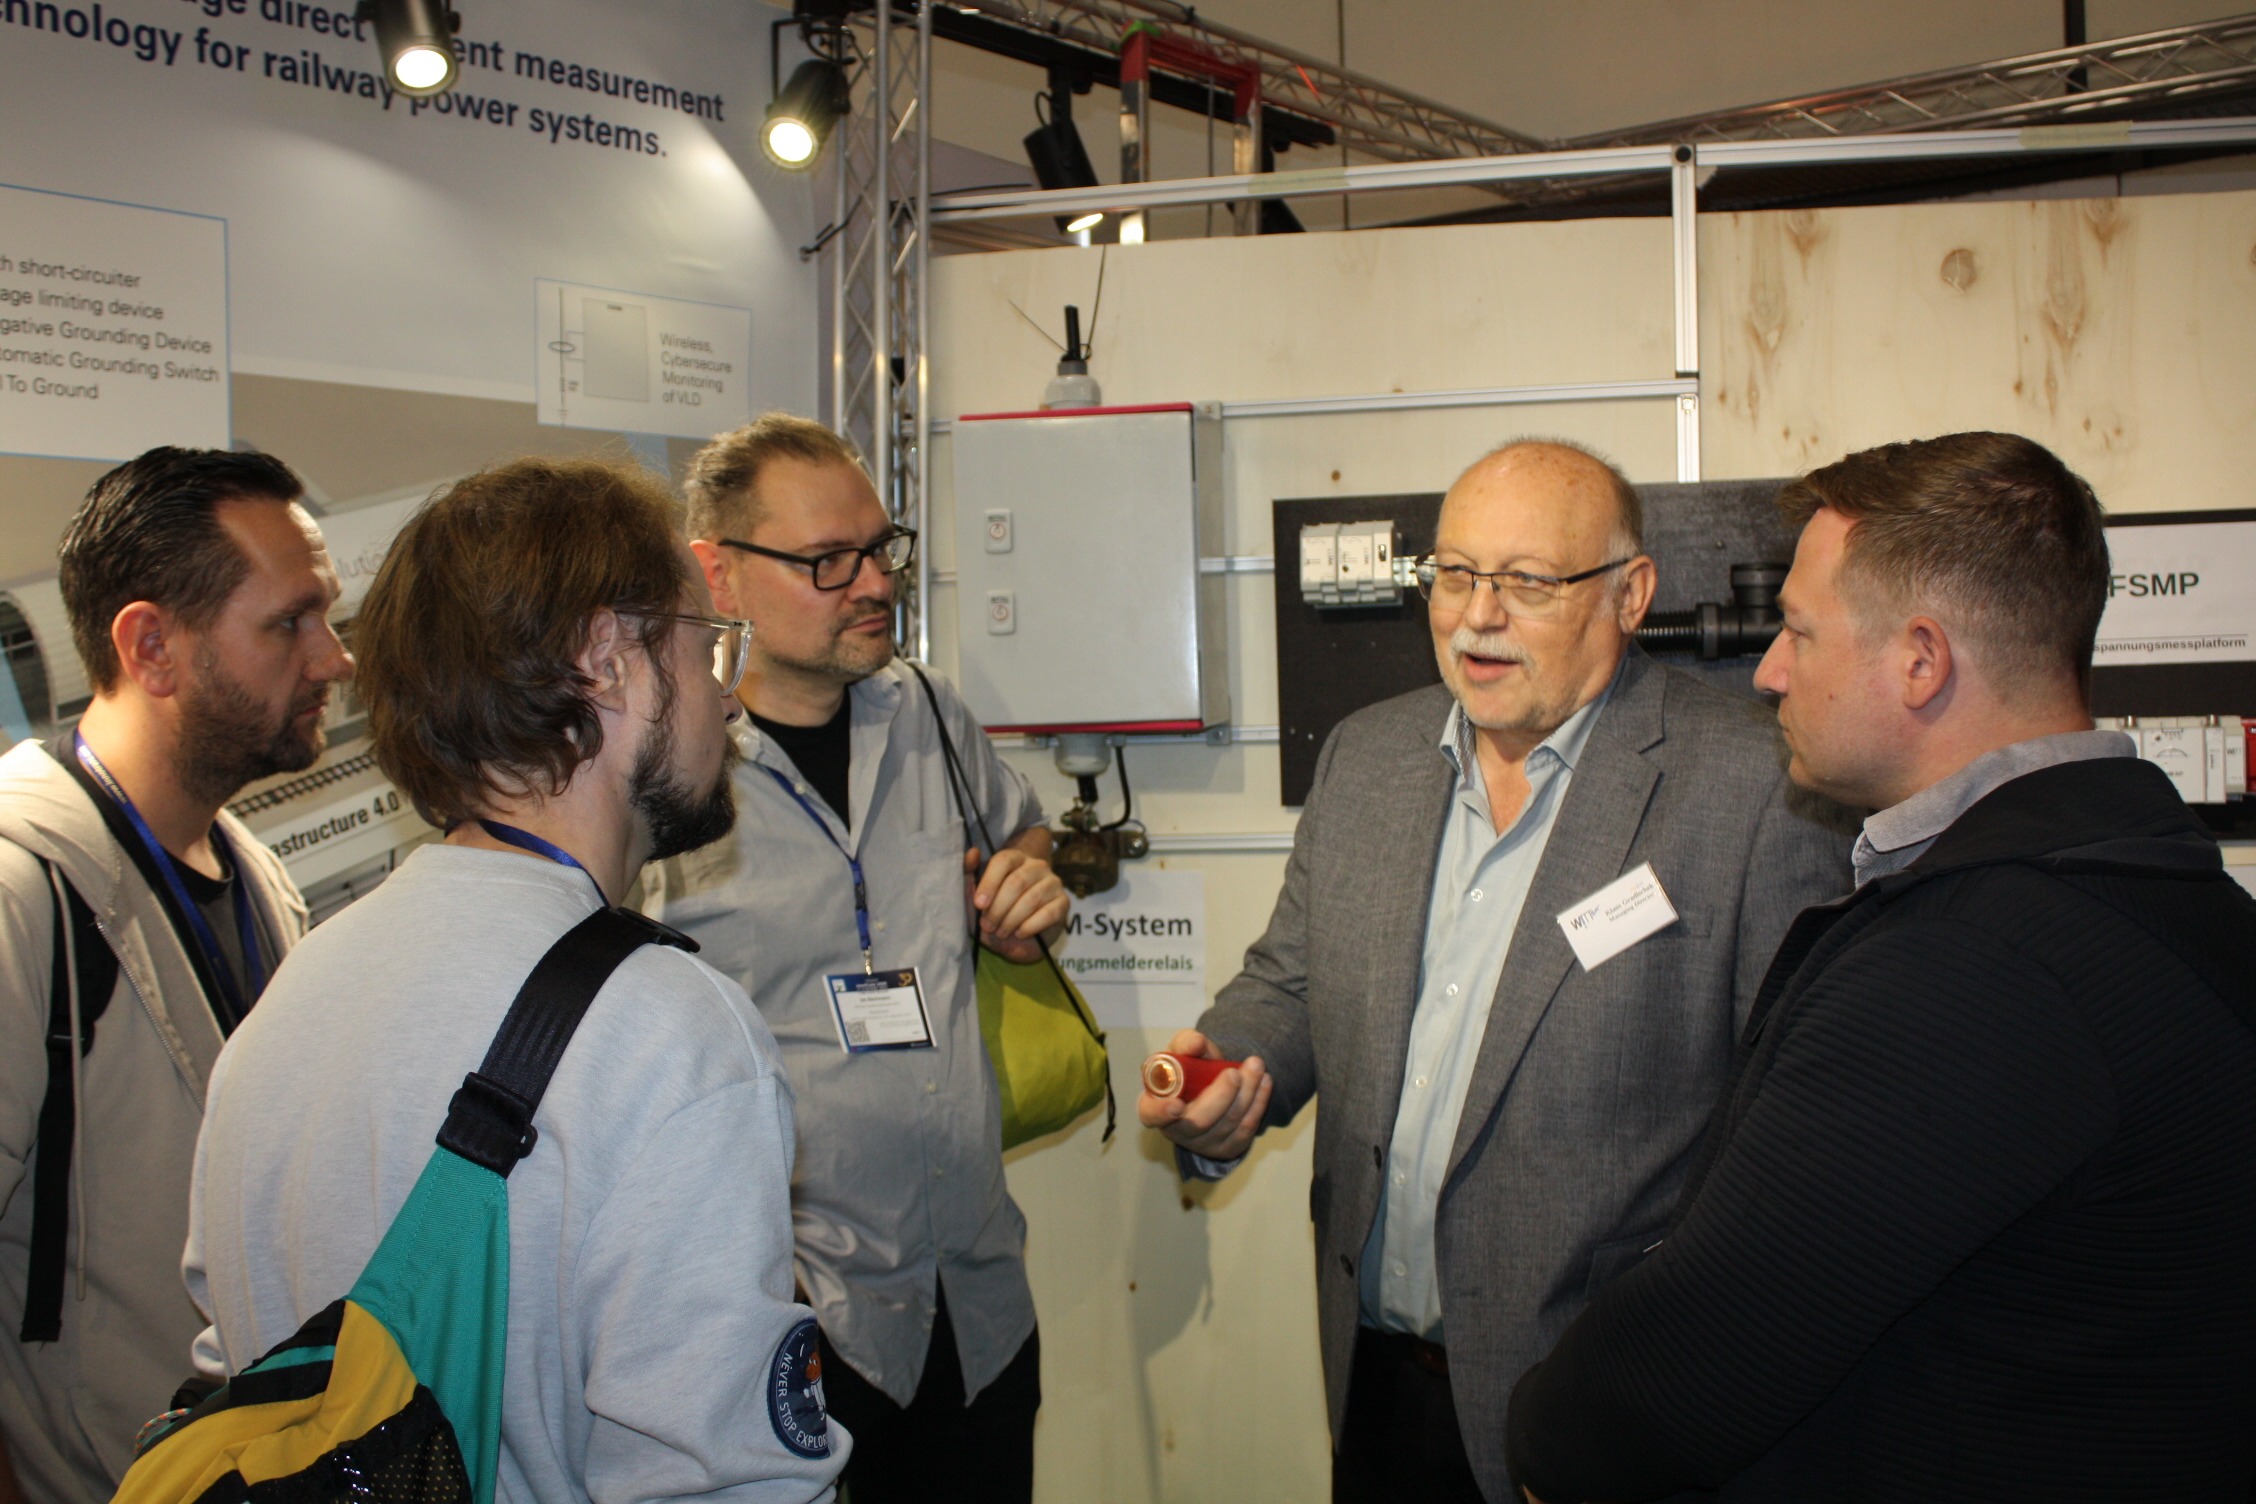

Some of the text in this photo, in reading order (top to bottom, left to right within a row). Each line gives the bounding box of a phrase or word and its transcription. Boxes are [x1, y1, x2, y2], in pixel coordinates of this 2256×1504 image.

[260, 0, 367, 42] direct
[449, 37, 504, 72] ent
[515, 51, 725, 122] measurement
[0, 0, 667, 157] hnology for railway power systems.
[18, 258, 142, 288] short-circuiter
[38, 289, 104, 317] limiting
[107, 300, 165, 321] device
[59, 321, 151, 350] Grounding
[155, 331, 213, 355] Device
[0, 346, 220, 382] omatic Grounding Switch
[660, 350, 732, 374] Cybersecure
[6, 374, 28, 393] To
[32, 376, 99, 400] Ground
[661, 369, 724, 394] Monitoring
[661, 389, 702, 407] of VLD
[2108, 571, 2200, 598] FSMP
[373, 791, 400, 817] 4.0
[777, 1352, 793, 1397] NEVER
[779, 1401, 798, 1431] STOP
